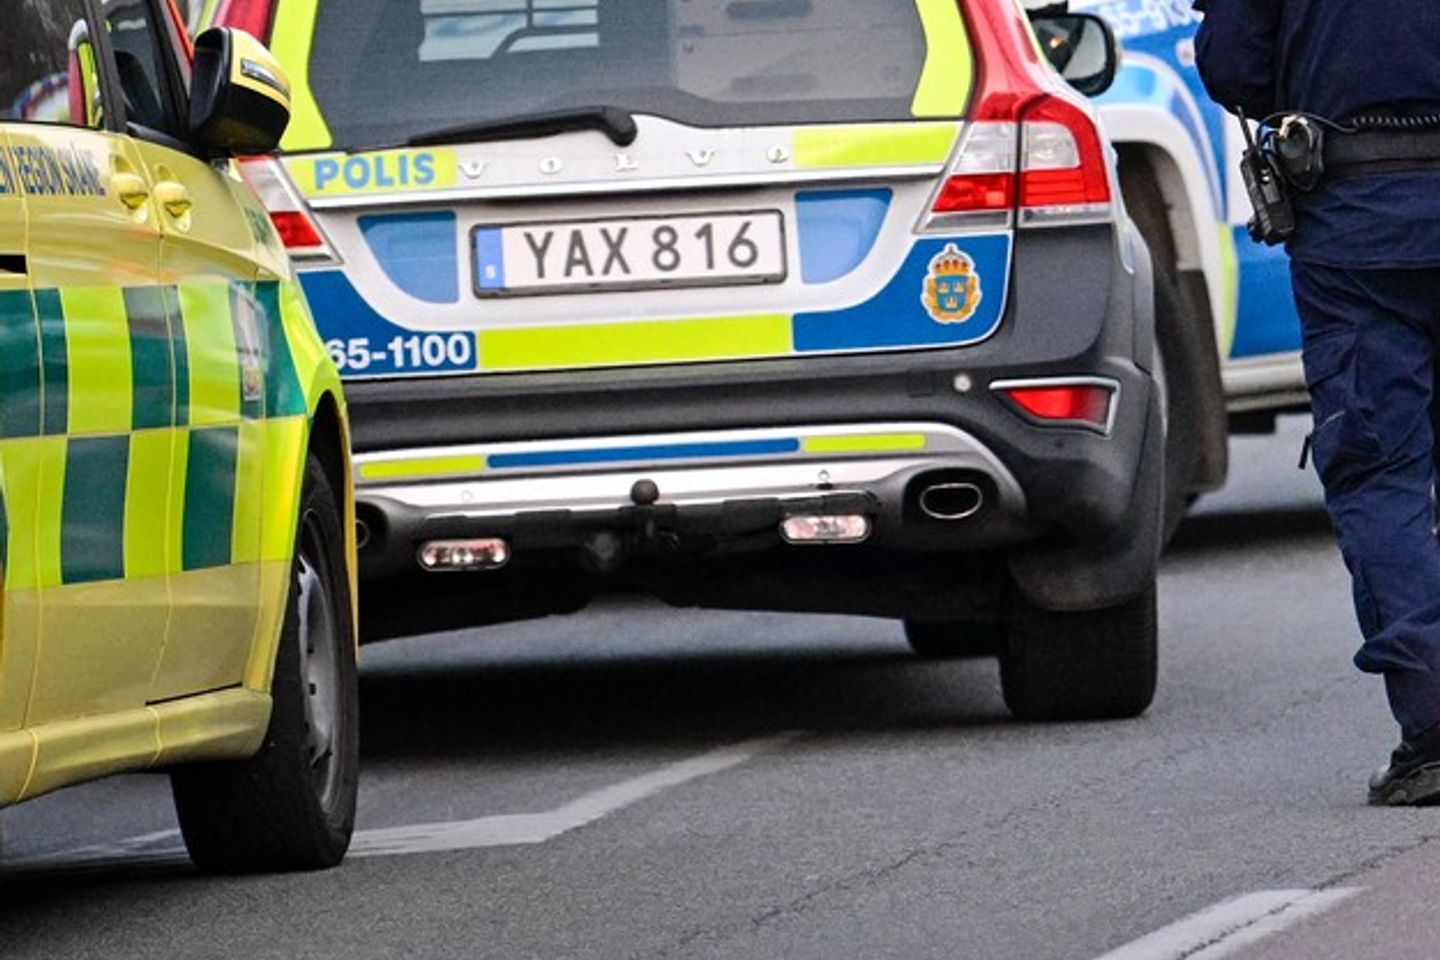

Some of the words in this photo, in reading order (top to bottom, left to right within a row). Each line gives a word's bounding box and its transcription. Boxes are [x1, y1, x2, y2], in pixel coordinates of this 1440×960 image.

[315, 152, 435, 190] POLIS
[523, 227, 631, 279] YAX
[652, 221, 759, 272] 816
[324, 332, 471, 370] 65-1100
